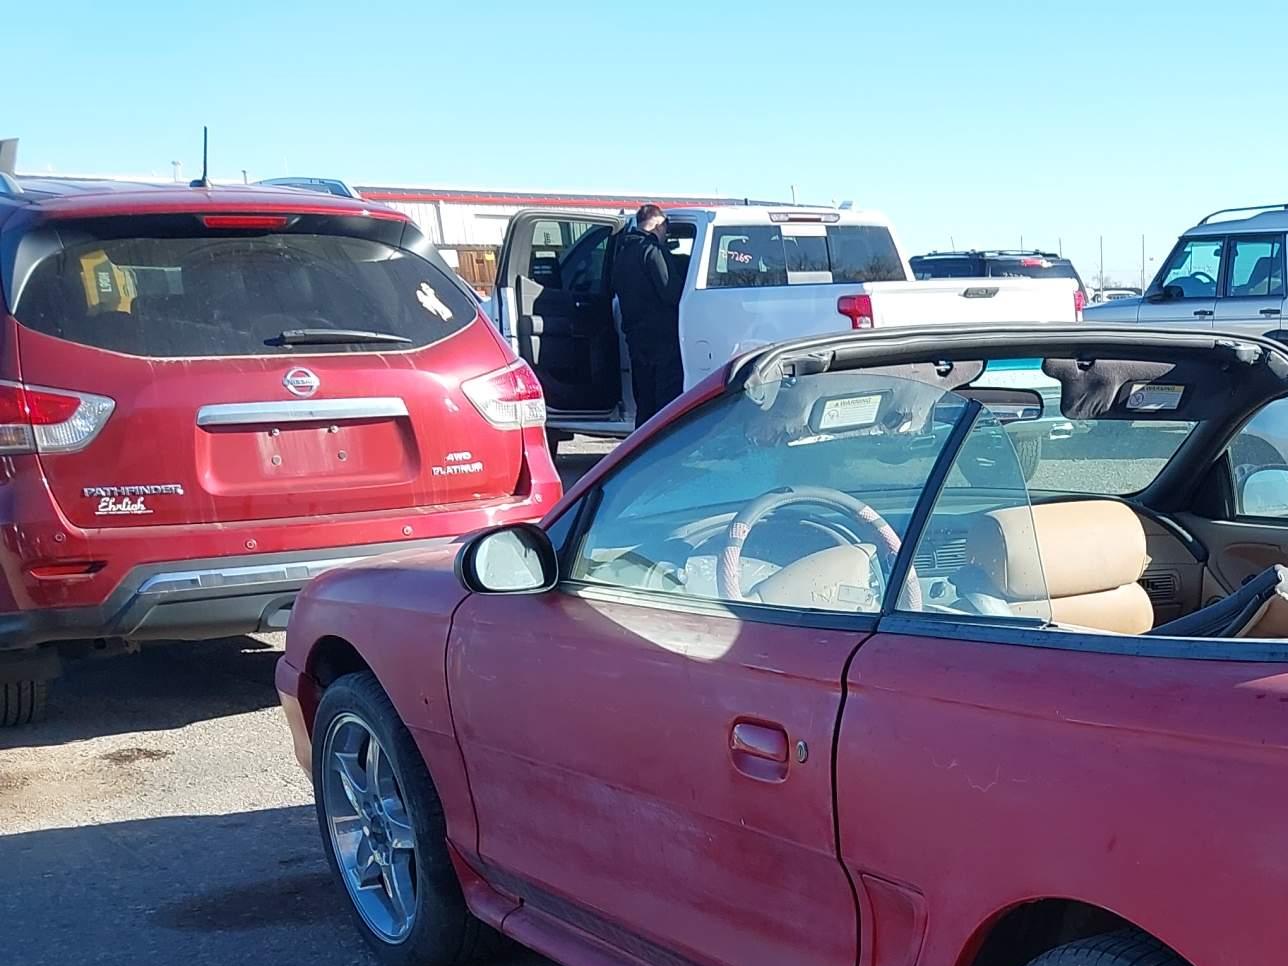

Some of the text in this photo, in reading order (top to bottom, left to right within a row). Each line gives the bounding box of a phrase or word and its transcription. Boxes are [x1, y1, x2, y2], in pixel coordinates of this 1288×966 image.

[446, 452, 472, 462] 4WD
[432, 462, 484, 476] PLATINUM
[83, 484, 183, 497] PATHFINDER
